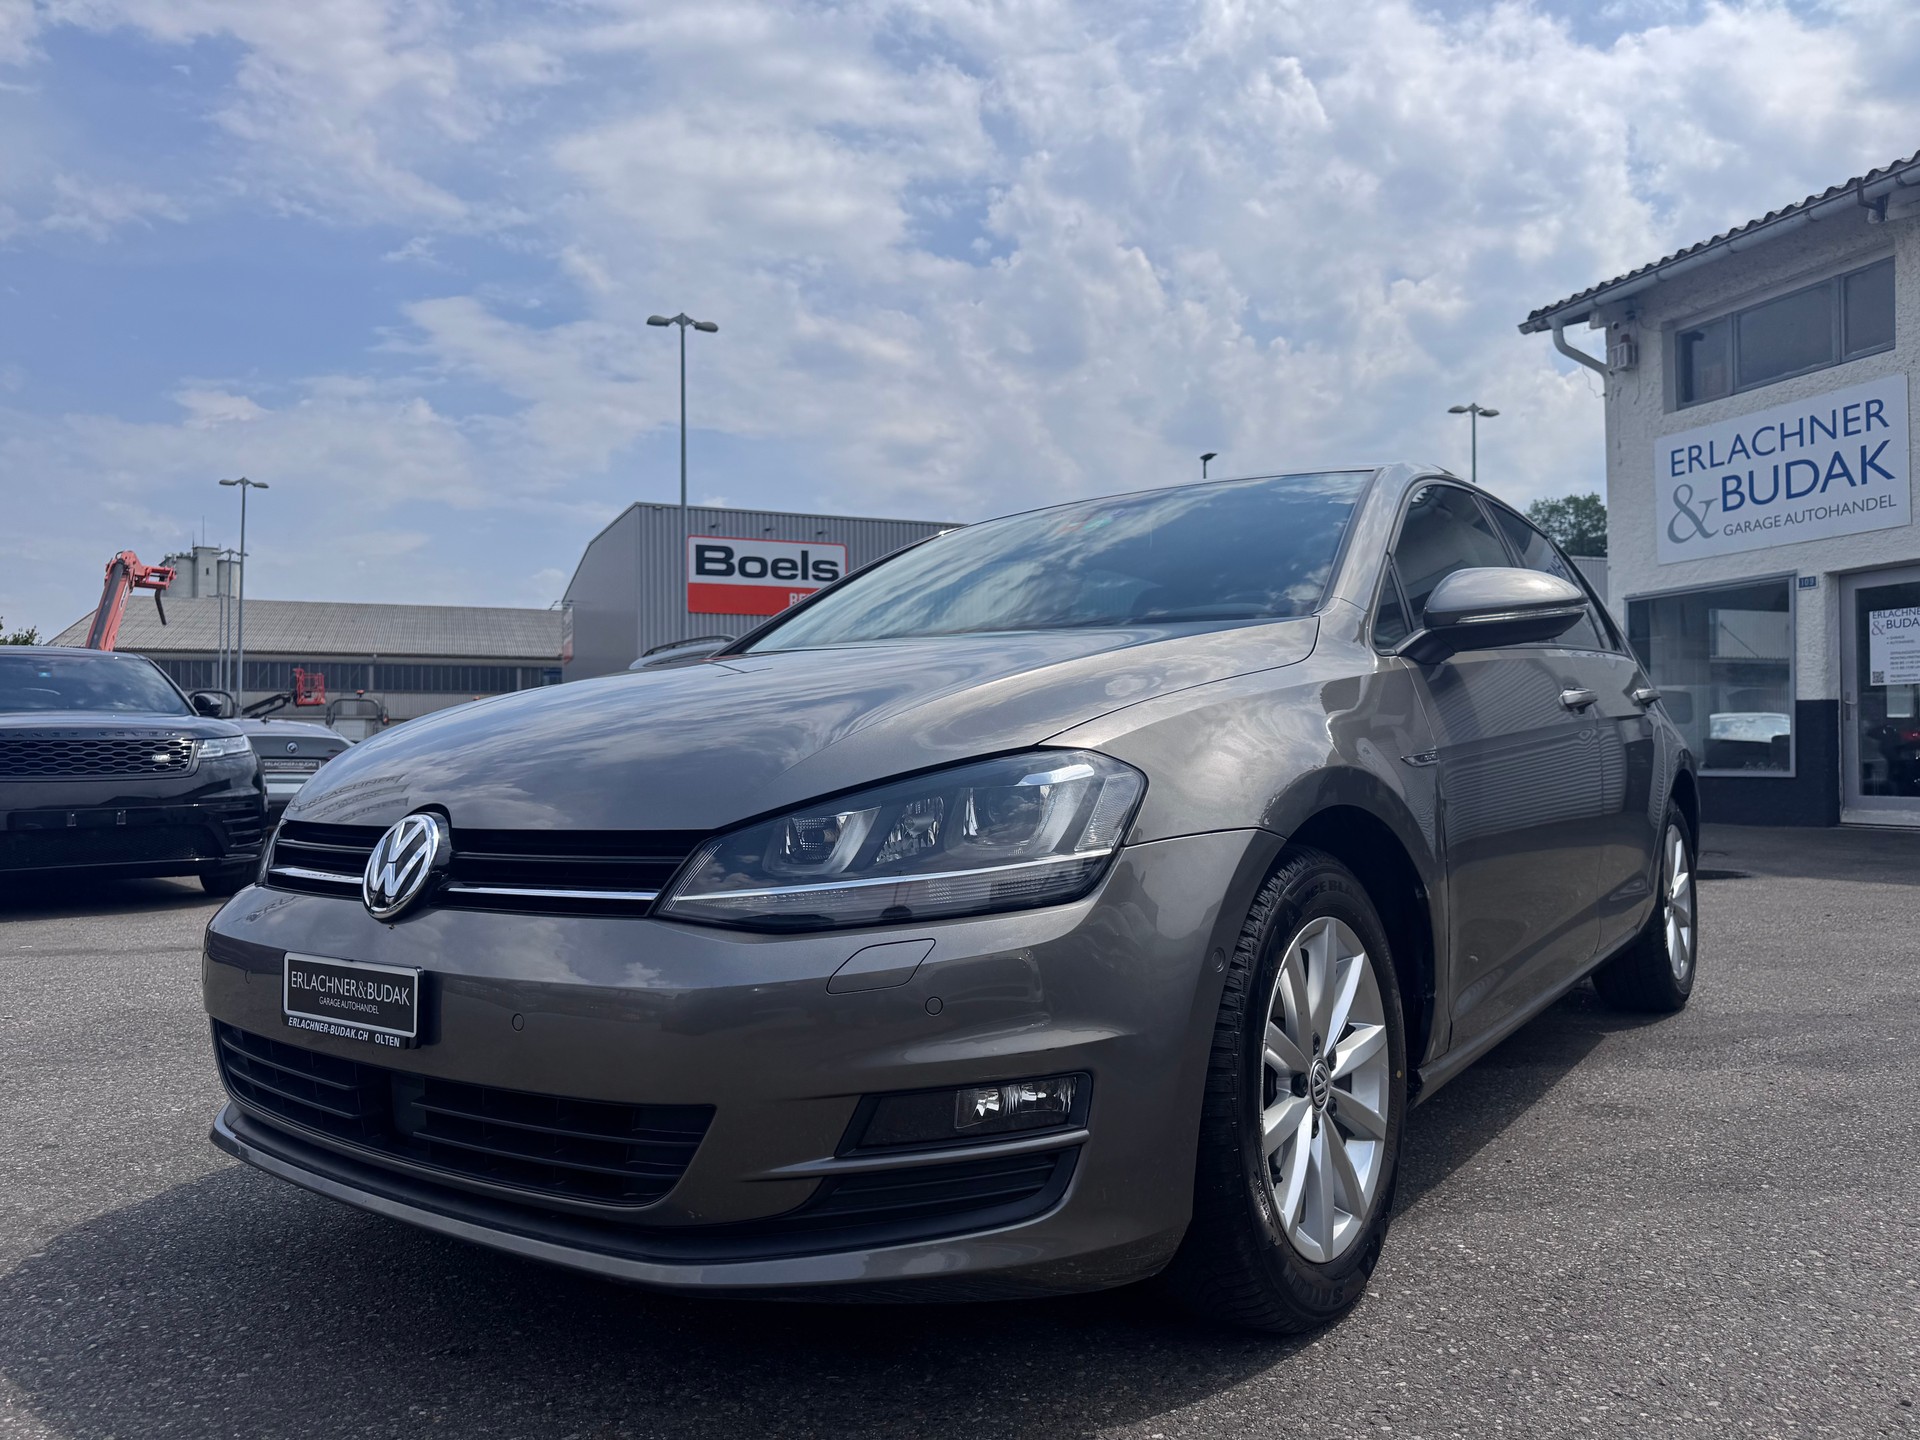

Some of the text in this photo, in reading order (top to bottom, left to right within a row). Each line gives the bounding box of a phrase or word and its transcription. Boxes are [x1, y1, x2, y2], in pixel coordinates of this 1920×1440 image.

[1670, 398, 1890, 477] ERLACHNER
[1667, 439, 1896, 544] & BUDAK
[1723, 494, 1897, 537] GARAGE AUTOHANDEL
[695, 544, 840, 582] Boels
[292, 971, 410, 1006] ERLACHNER&BUDAK
[319, 997, 380, 1014] GARAGE AUTOHANDEL
[288, 1018, 400, 1047] ERLACHNER-BUDAK.CH OLTEN
